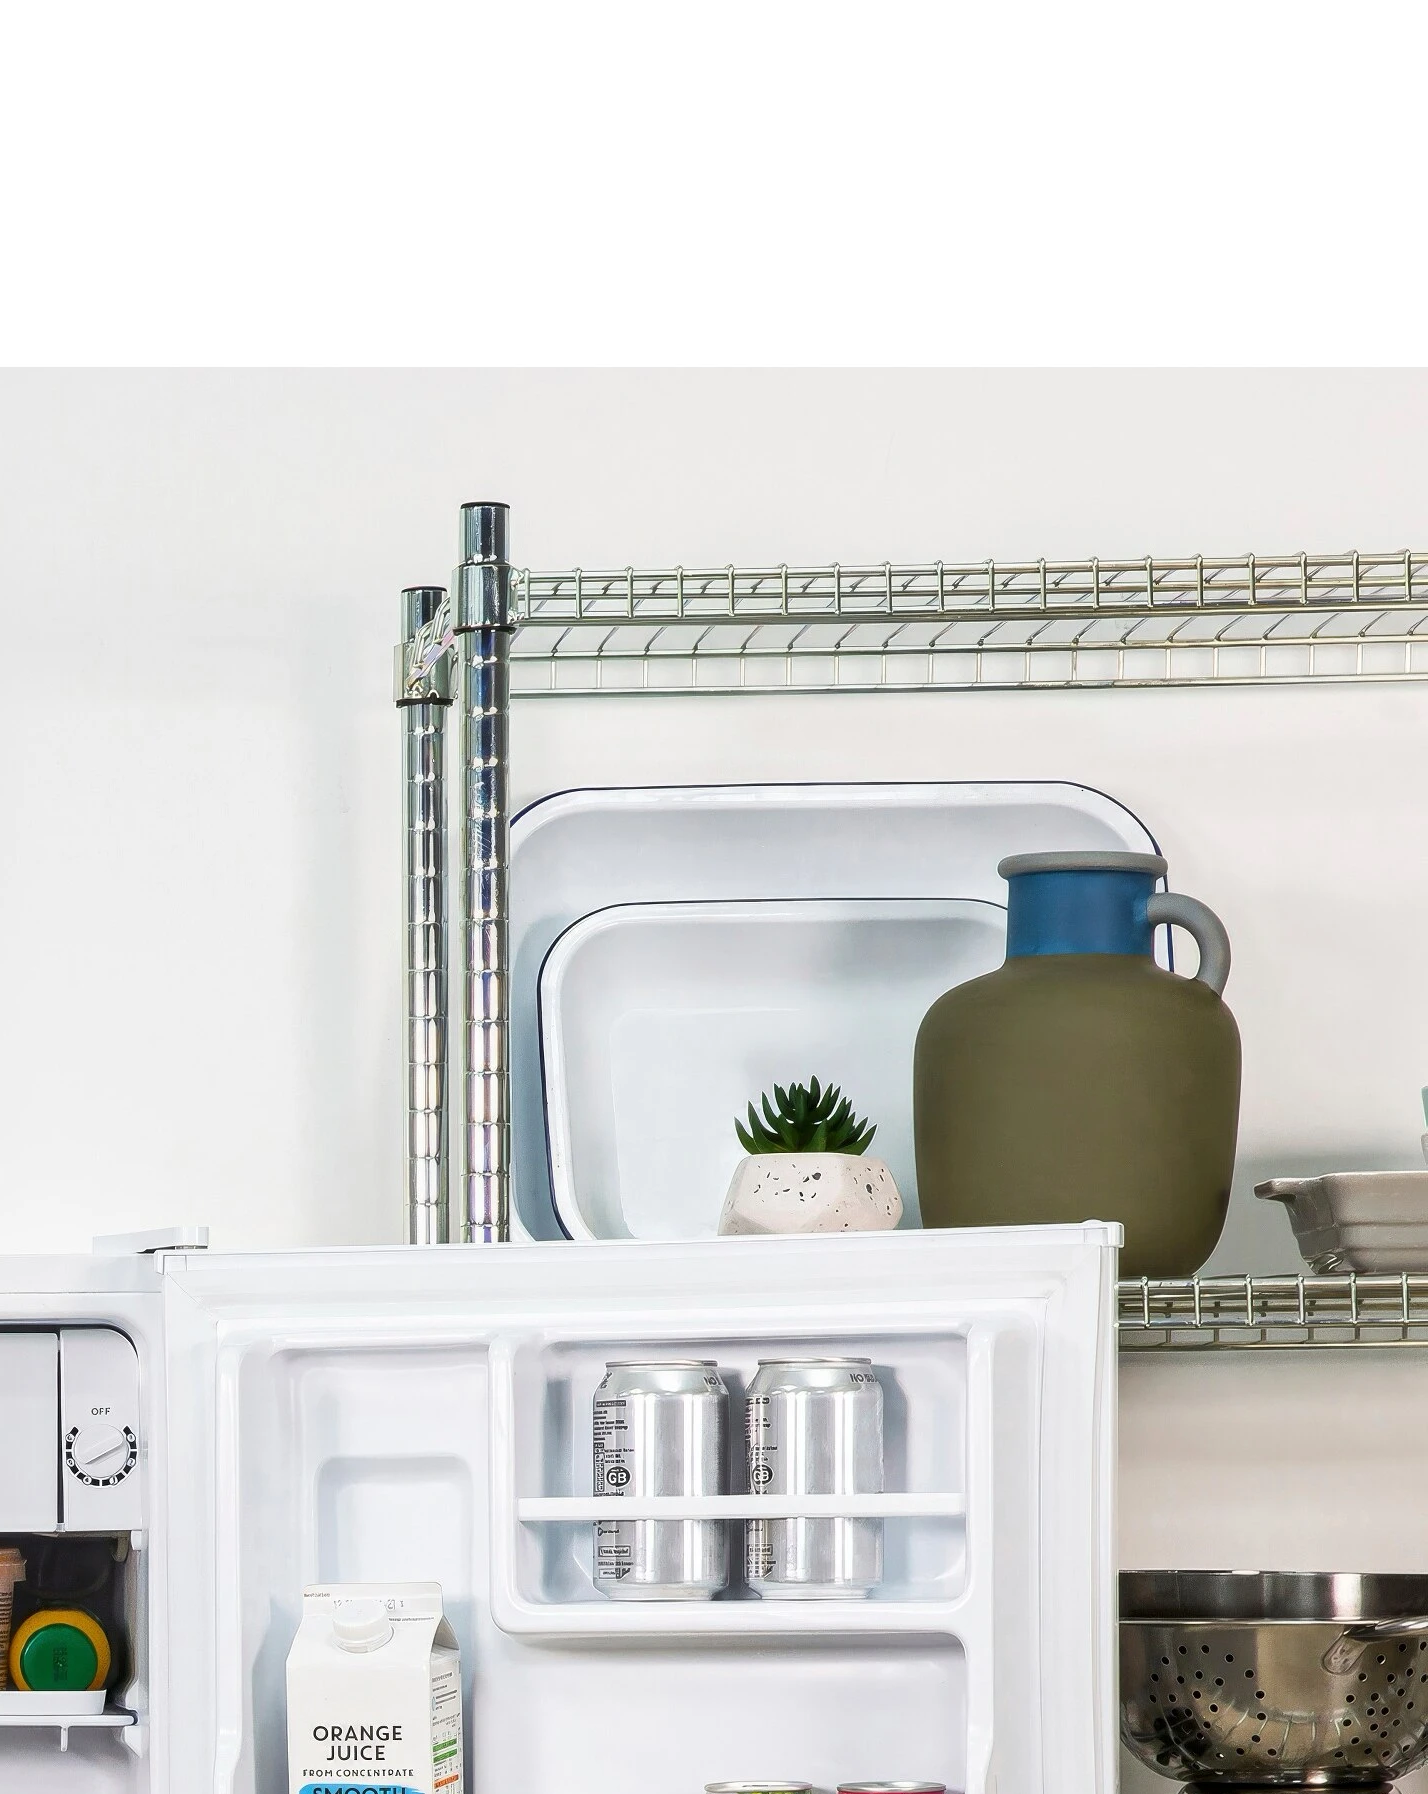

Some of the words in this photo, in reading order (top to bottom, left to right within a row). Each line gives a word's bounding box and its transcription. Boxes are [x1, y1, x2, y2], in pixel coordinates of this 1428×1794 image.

[91, 1407, 111, 1416] OFF
[608, 1472, 627, 1484] GB
[313, 1725, 403, 1741] ORANGE
[326, 1745, 386, 1761] JUICE
[303, 1769, 333, 1777] FROM
[336, 1769, 414, 1777] CONCENTRATE
